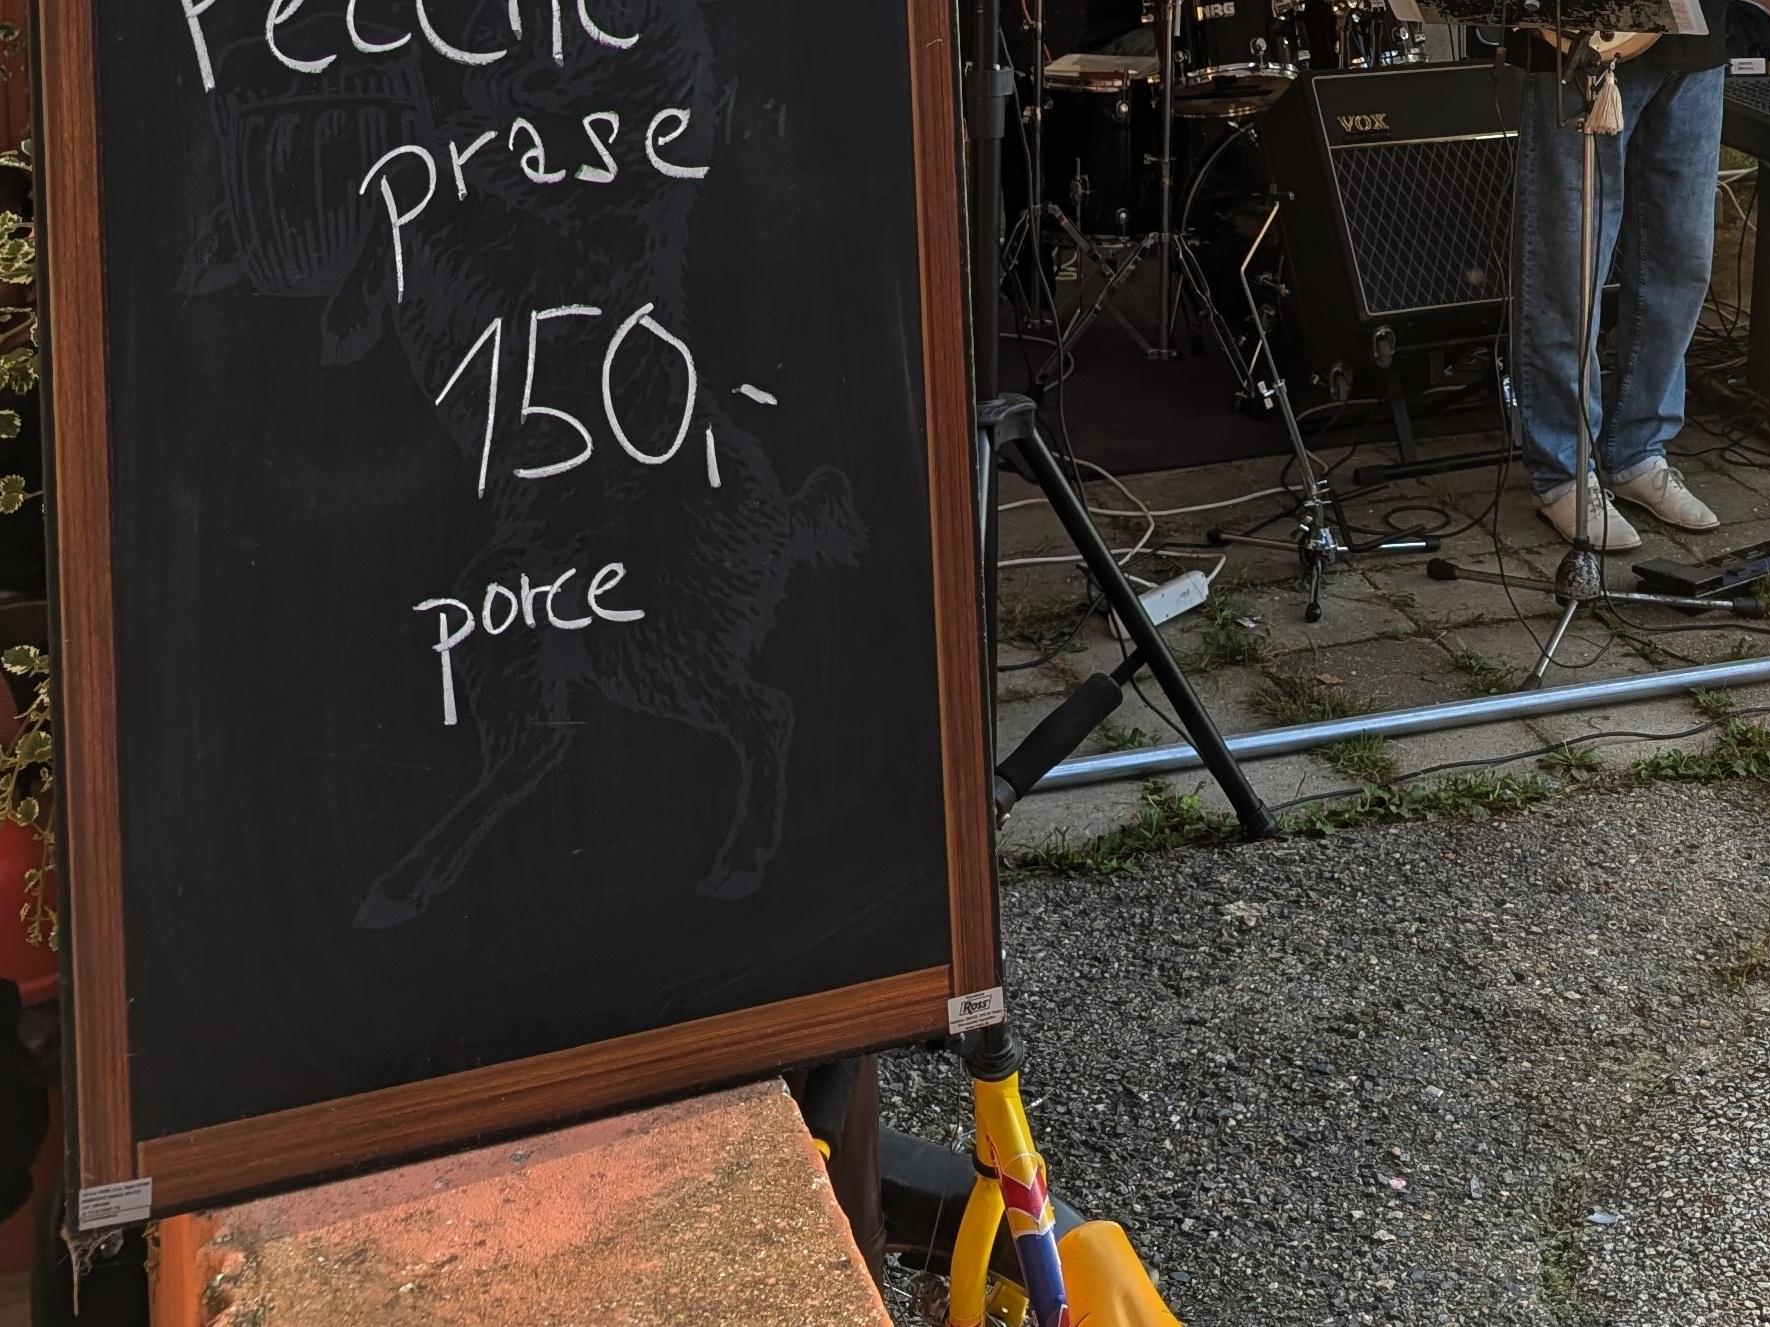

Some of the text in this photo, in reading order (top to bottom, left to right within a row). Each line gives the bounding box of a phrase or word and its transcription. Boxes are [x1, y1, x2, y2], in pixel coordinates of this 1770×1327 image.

[358, 107, 712, 304] prase
[1336, 113, 1390, 133] VOX
[411, 561, 647, 727] porce
